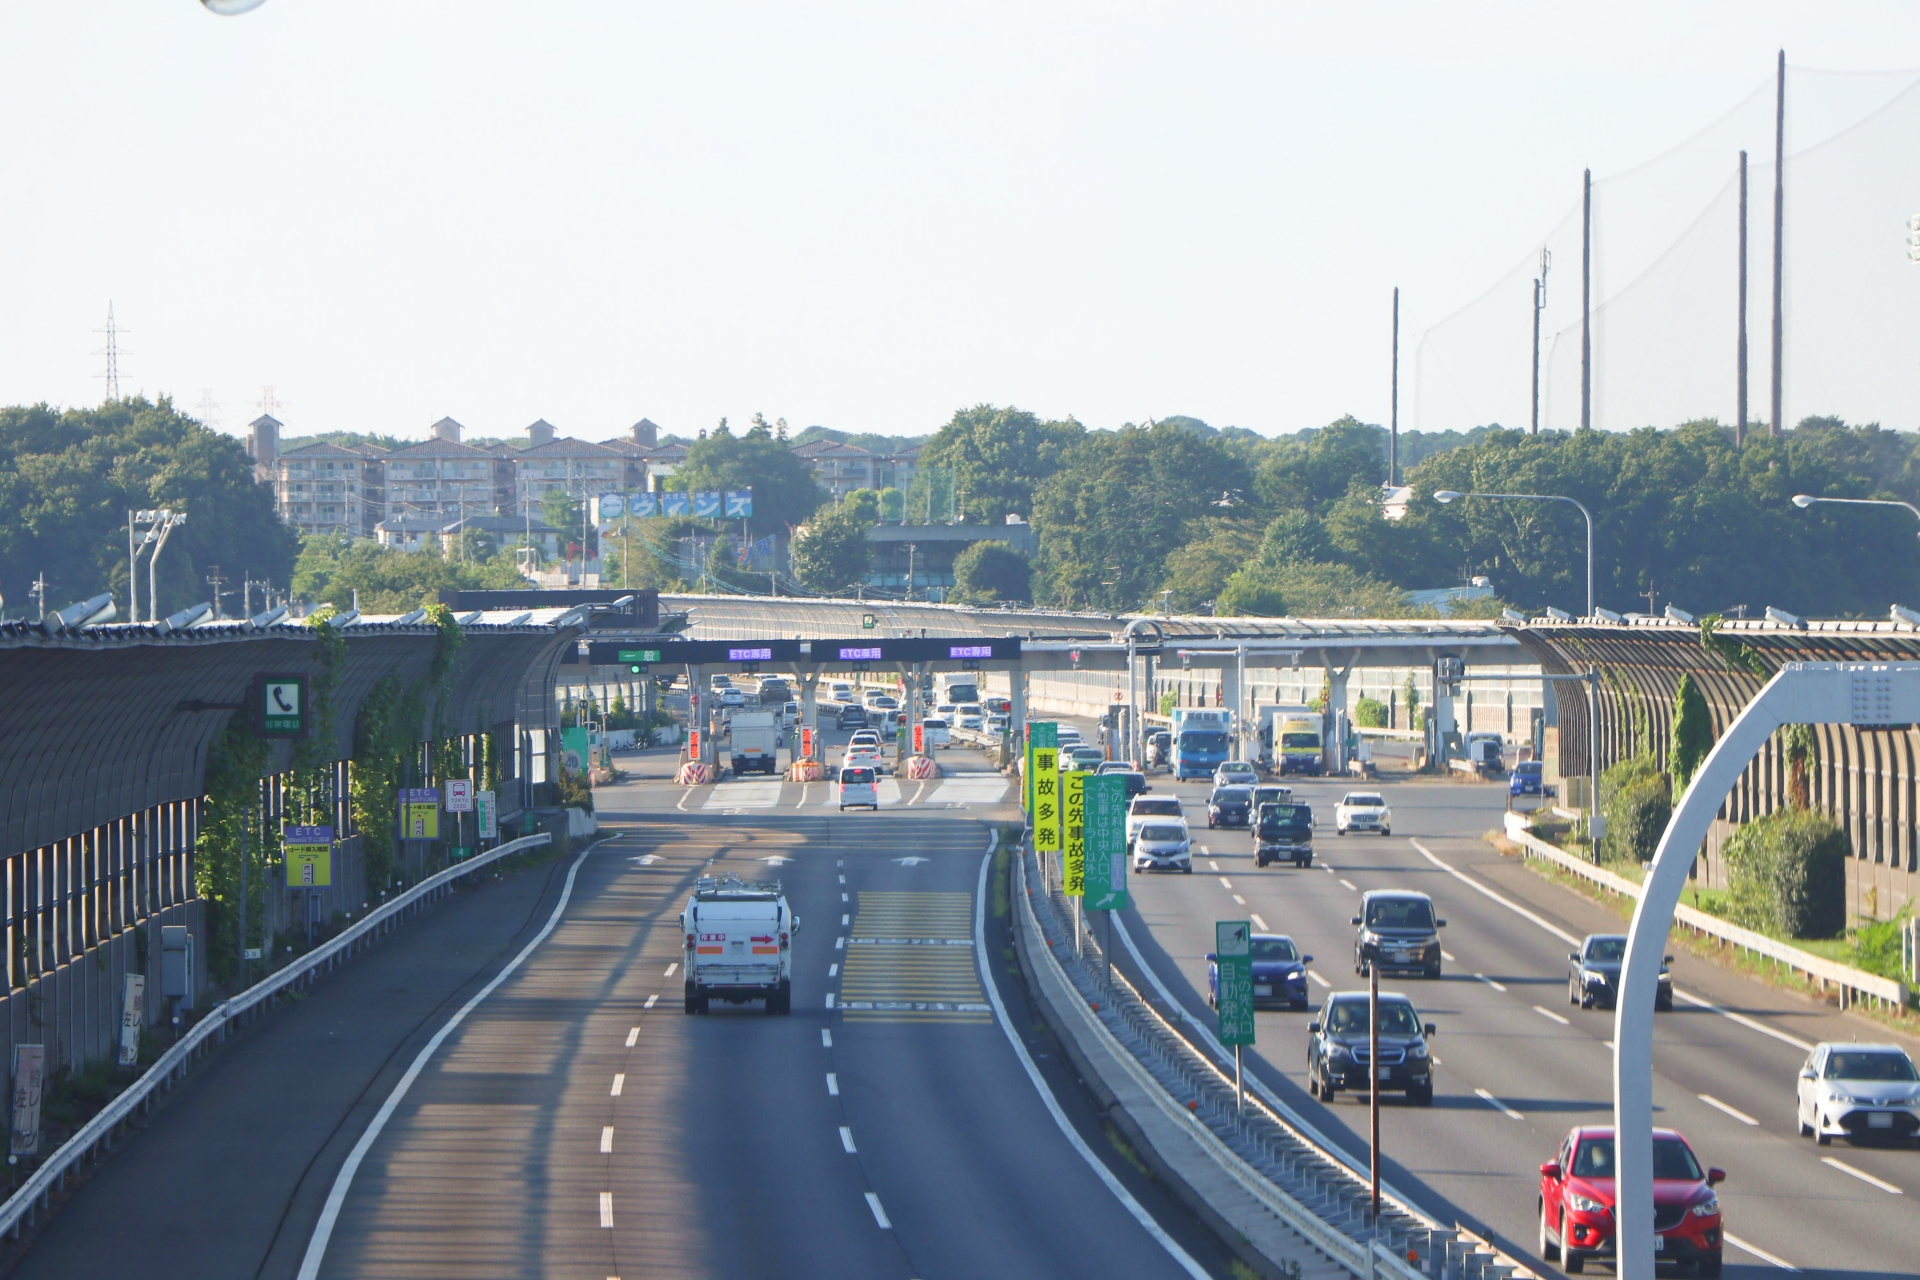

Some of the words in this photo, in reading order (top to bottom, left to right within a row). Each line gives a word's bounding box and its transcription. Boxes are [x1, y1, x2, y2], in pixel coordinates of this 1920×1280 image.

[625, 650, 655, 662] 一般
[729, 648, 771, 660] ETC専用
[839, 648, 882, 659] ETC専用
[950, 646, 992, 658] ETC専用
[566, 756, 578, 768] 40
[409, 788, 430, 797] ETC
[1037, 753, 1055, 846] 事故多発
[1111, 779, 1123, 852] この先料金所
[295, 827, 321, 836] ETC
[1097, 780, 1110, 885] 大型車は中央入口へ
[303, 865, 311, 883] ETC
[1113, 854, 1123, 890] ETC
[1220, 961, 1240, 1040] 自動発券
[1238, 965, 1253, 1035] この先入口
